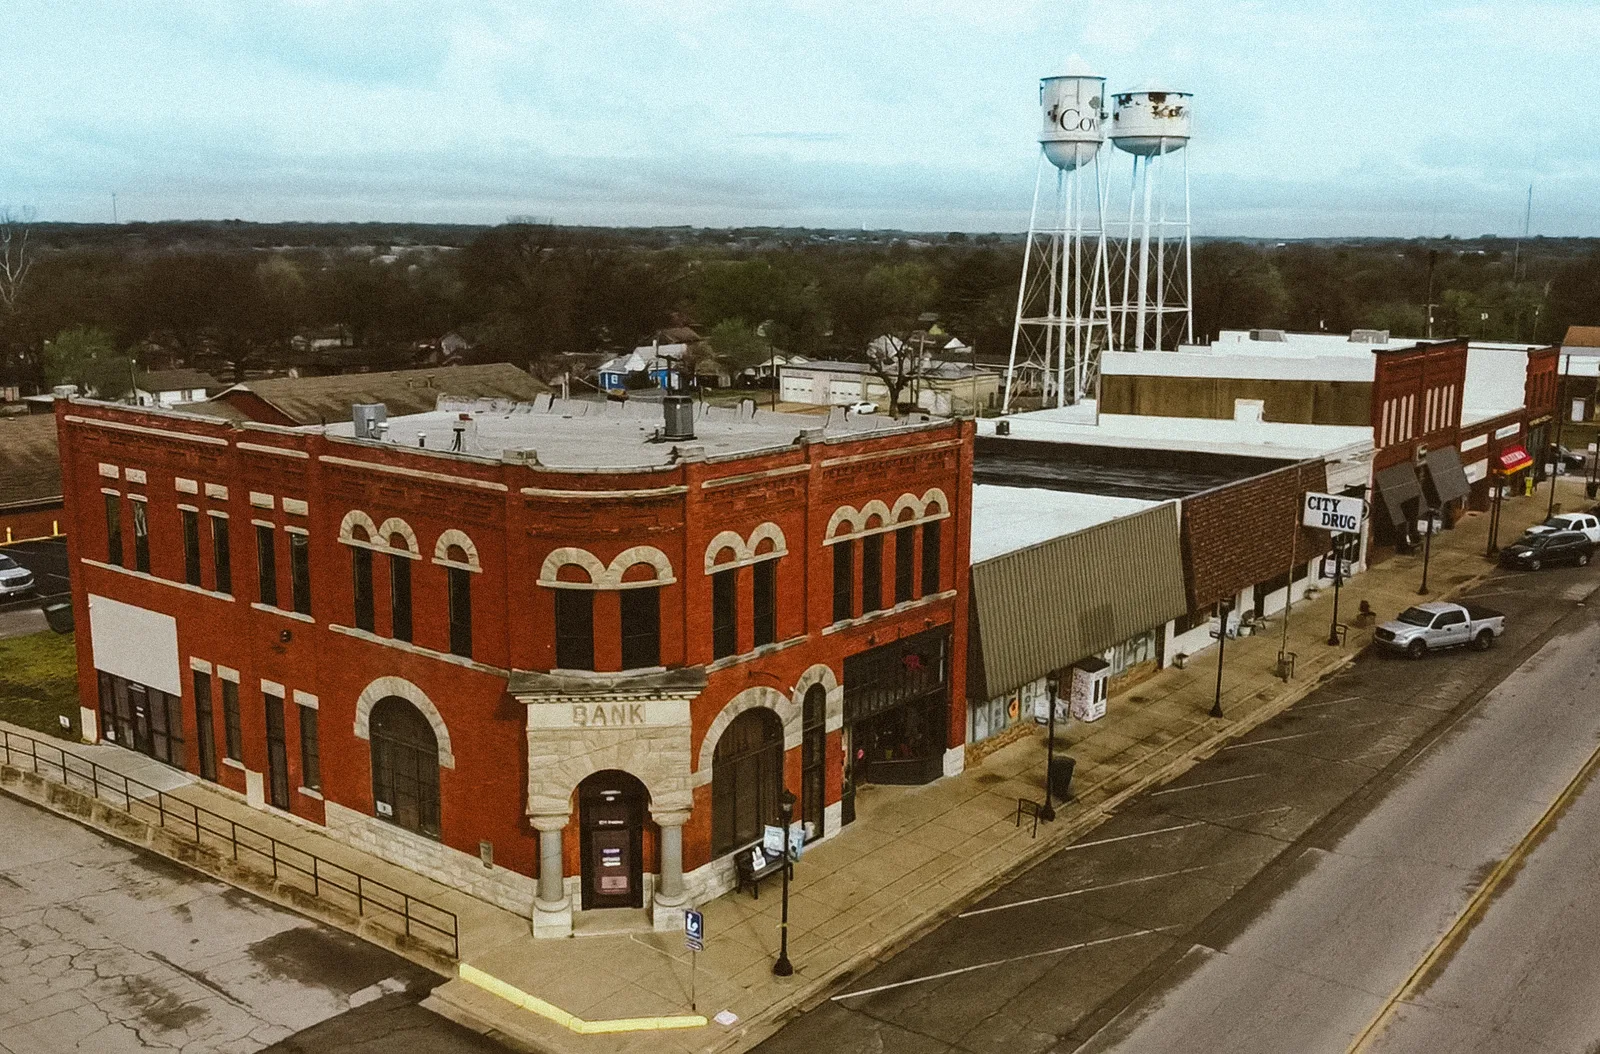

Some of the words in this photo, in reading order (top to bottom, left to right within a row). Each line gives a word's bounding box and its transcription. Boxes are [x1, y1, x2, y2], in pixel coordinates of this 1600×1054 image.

[1308, 496, 1340, 513] CITY
[1321, 512, 1357, 530] DRUG
[572, 703, 644, 727] BANK
